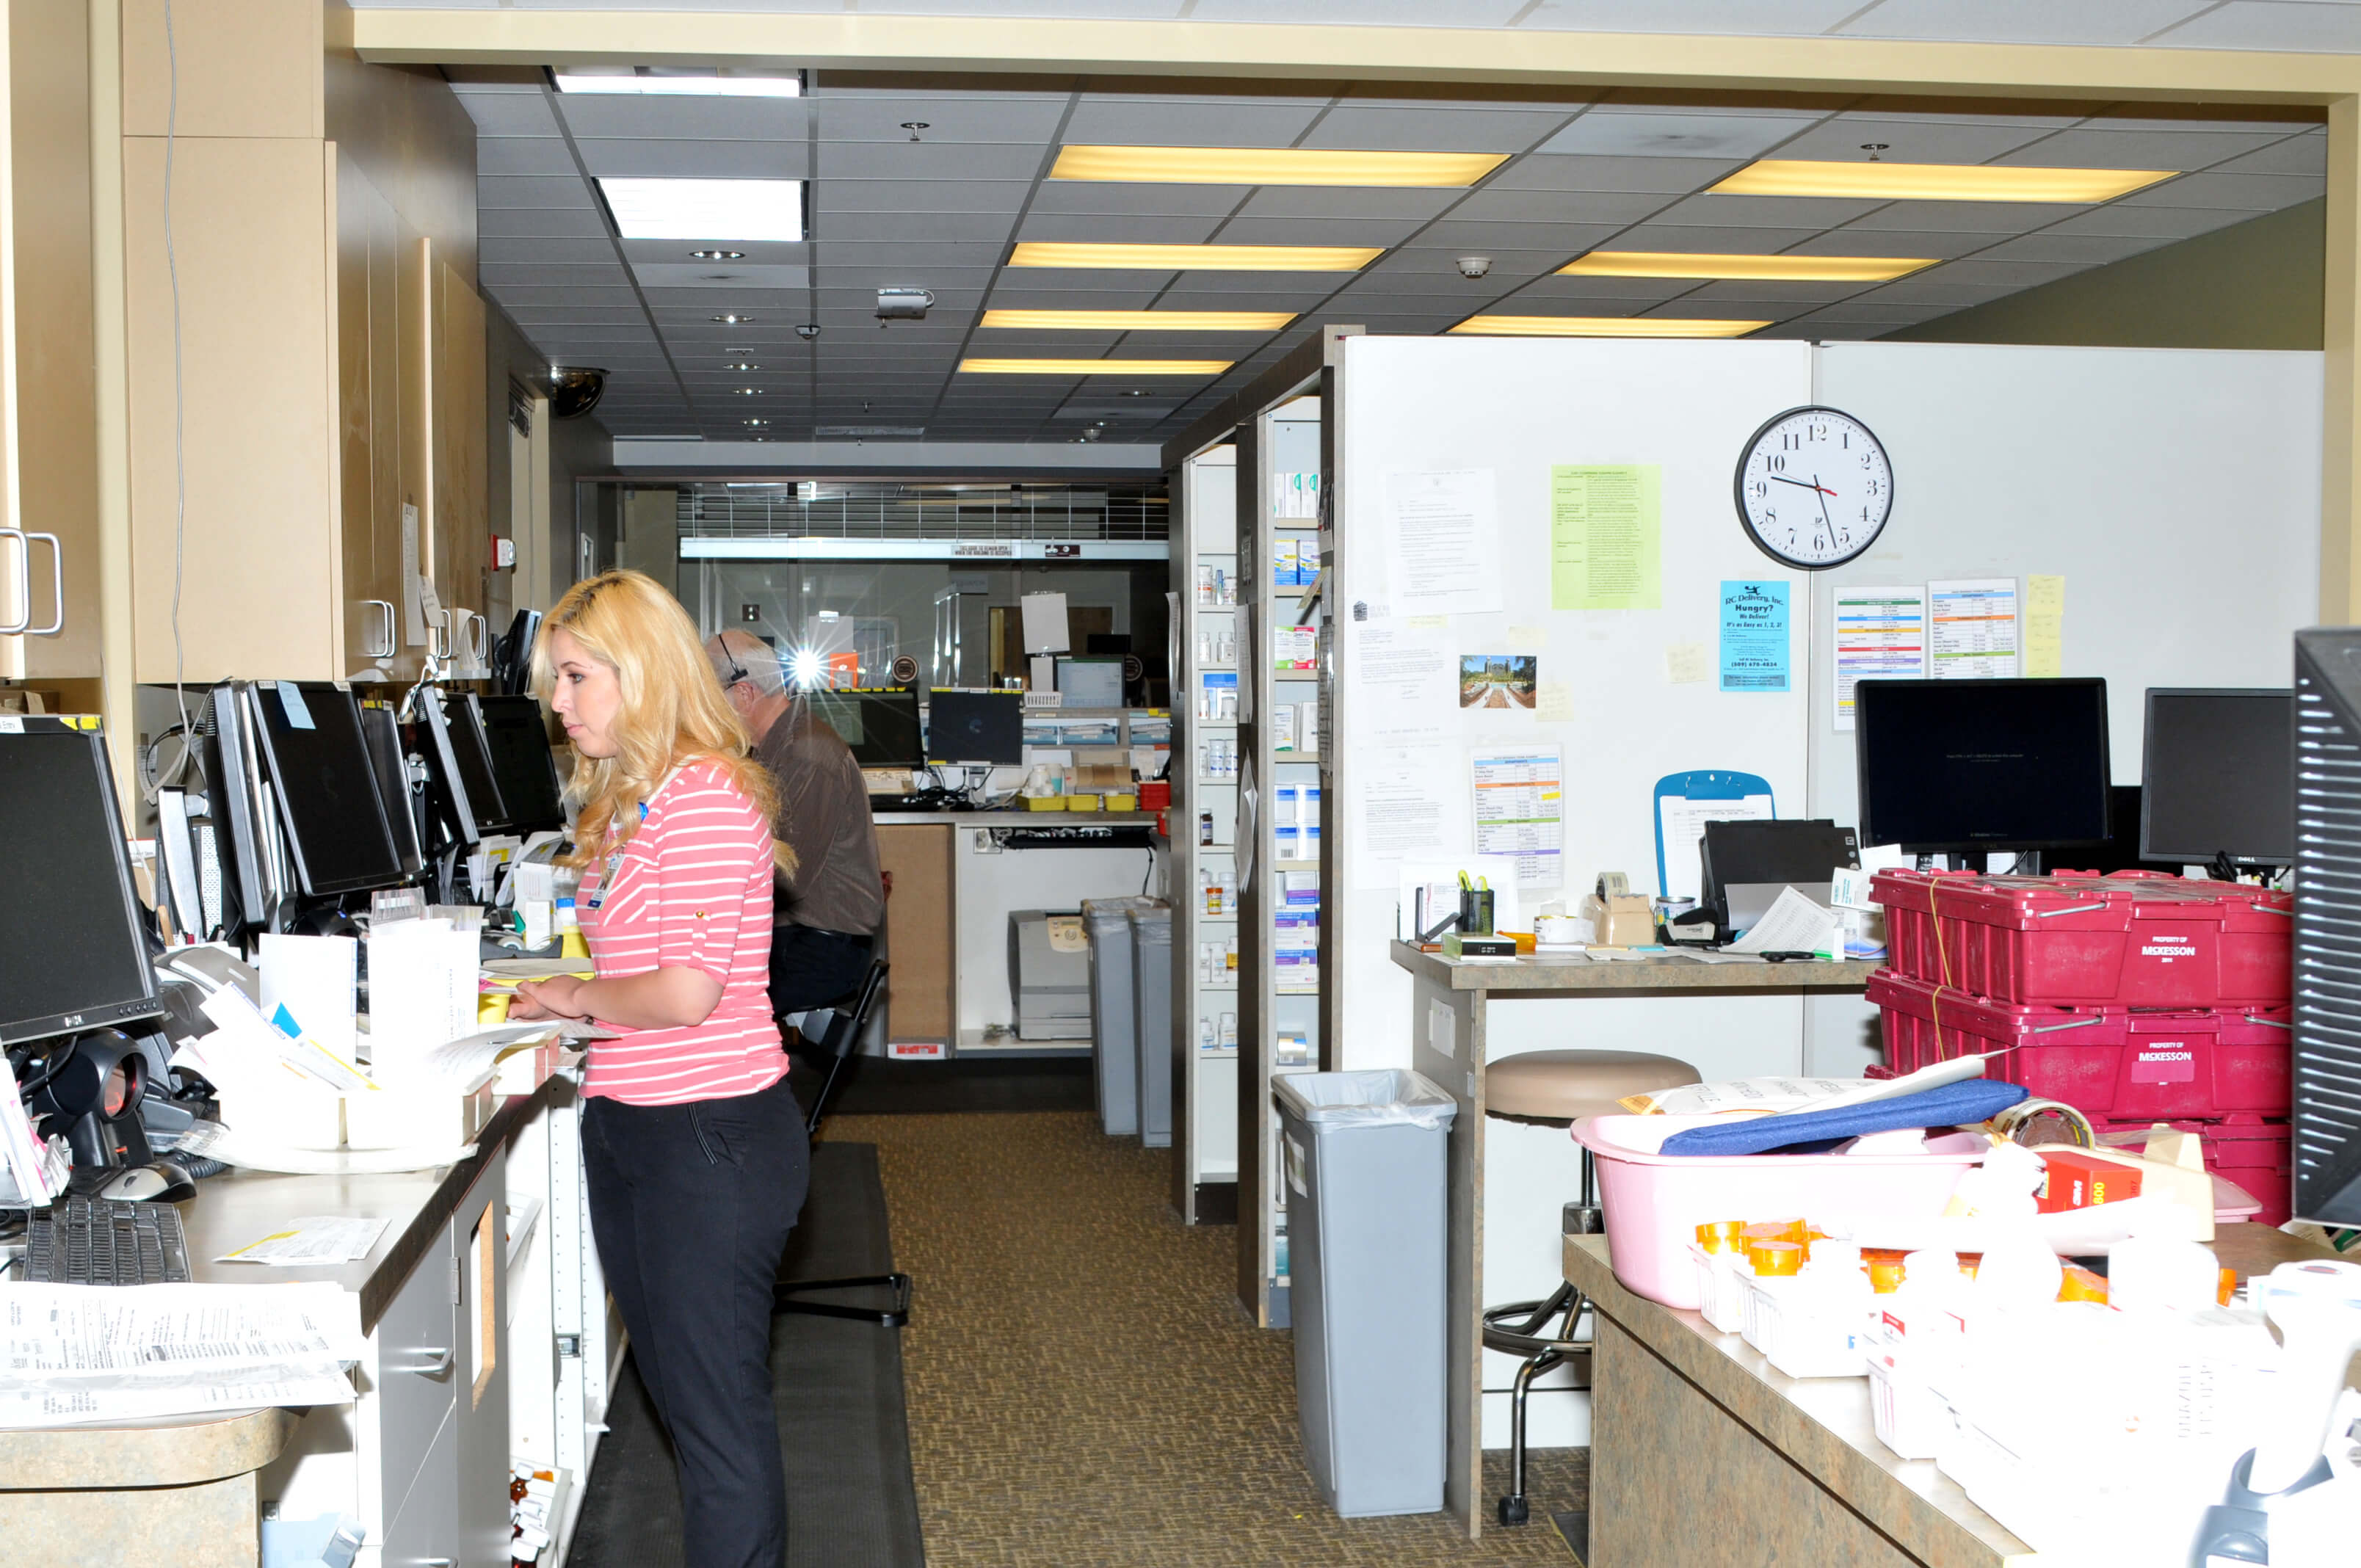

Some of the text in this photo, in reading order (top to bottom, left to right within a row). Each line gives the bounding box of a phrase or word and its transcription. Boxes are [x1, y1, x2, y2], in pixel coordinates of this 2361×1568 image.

[1807, 424, 1827, 441] 12
[1842, 432, 1849, 449] 1
[1782, 433, 1800, 450] 11
[1766, 455, 1785, 472] 10
[1860, 453, 1871, 470] 2
[1756, 481, 1766, 498] 9
[1867, 479, 1877, 496] 3
[1765, 507, 1776, 524] 8
[1860, 504, 1870, 522] 4
[1788, 528, 1797, 545] 7
[1813, 534, 1824, 551] 6
[1839, 526, 1850, 544] 5
[1725, 594, 1785, 605] RC Delivery, Inc.
[1735, 604, 1774, 613] Hungry?
